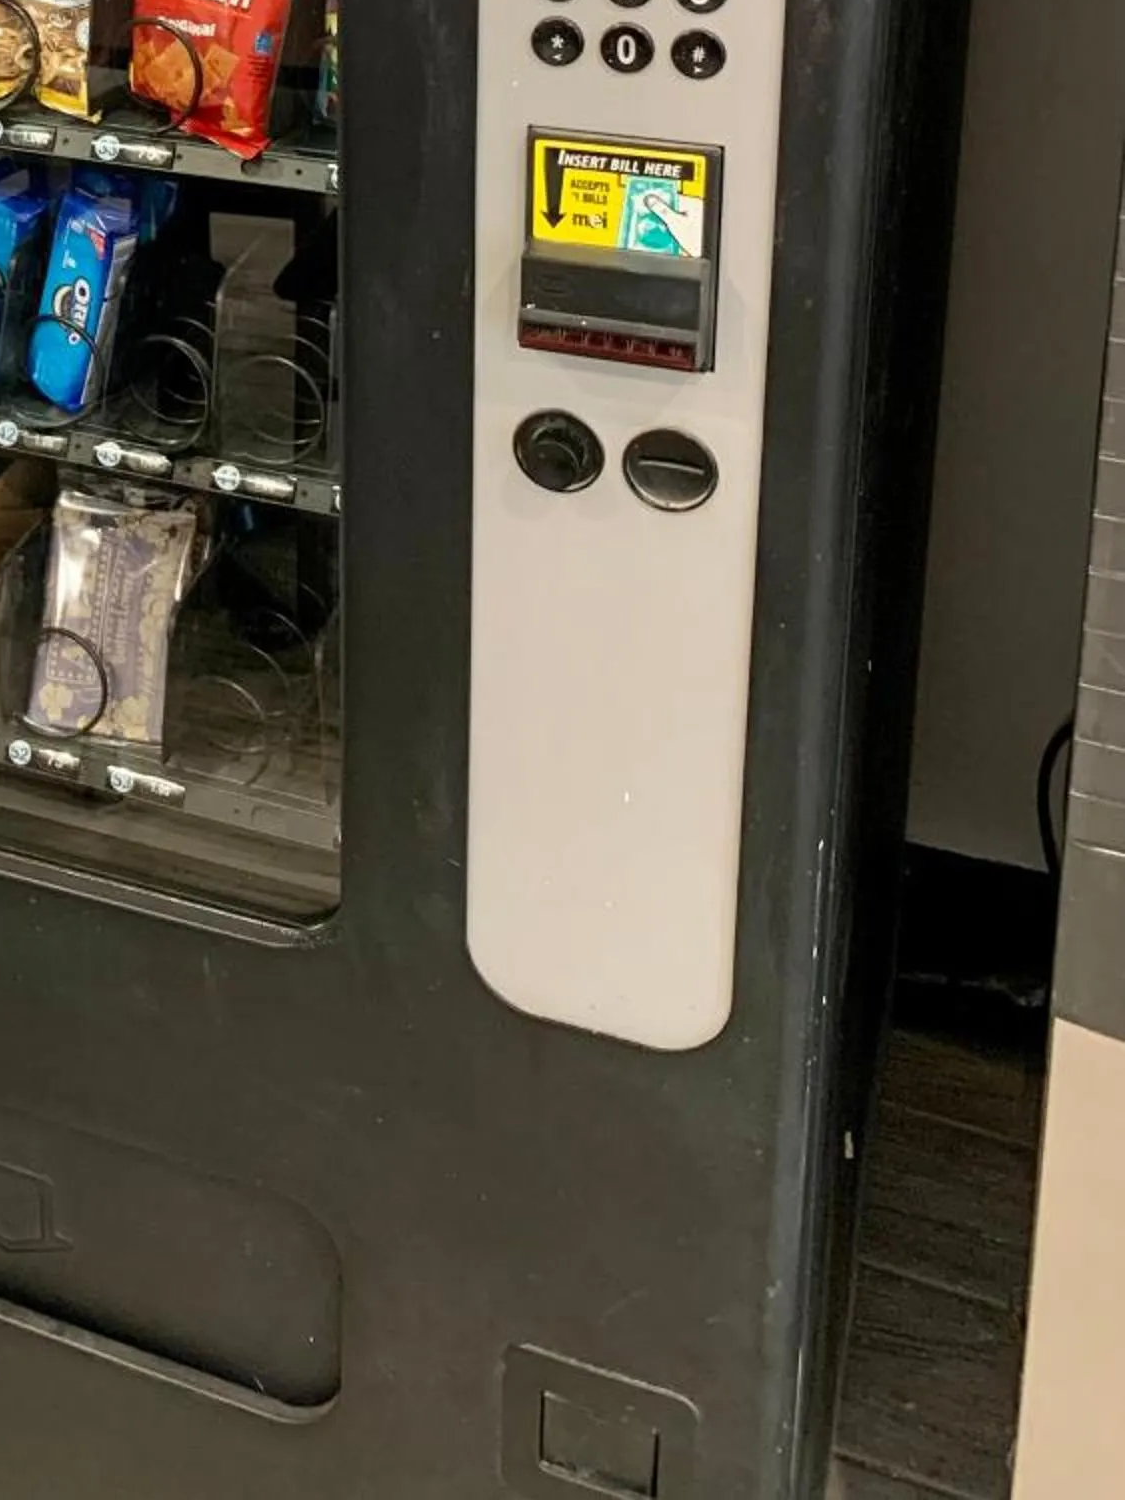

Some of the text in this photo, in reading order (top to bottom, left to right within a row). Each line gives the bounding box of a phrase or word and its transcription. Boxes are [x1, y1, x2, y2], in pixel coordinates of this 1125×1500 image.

[616, 34, 636, 65] 0
[558, 149, 683, 179] INSERT BILL HERE
[571, 179, 610, 192] ACCEPTS
[582, 193, 608, 205] BILLS
[572, 212, 607, 229] mei
